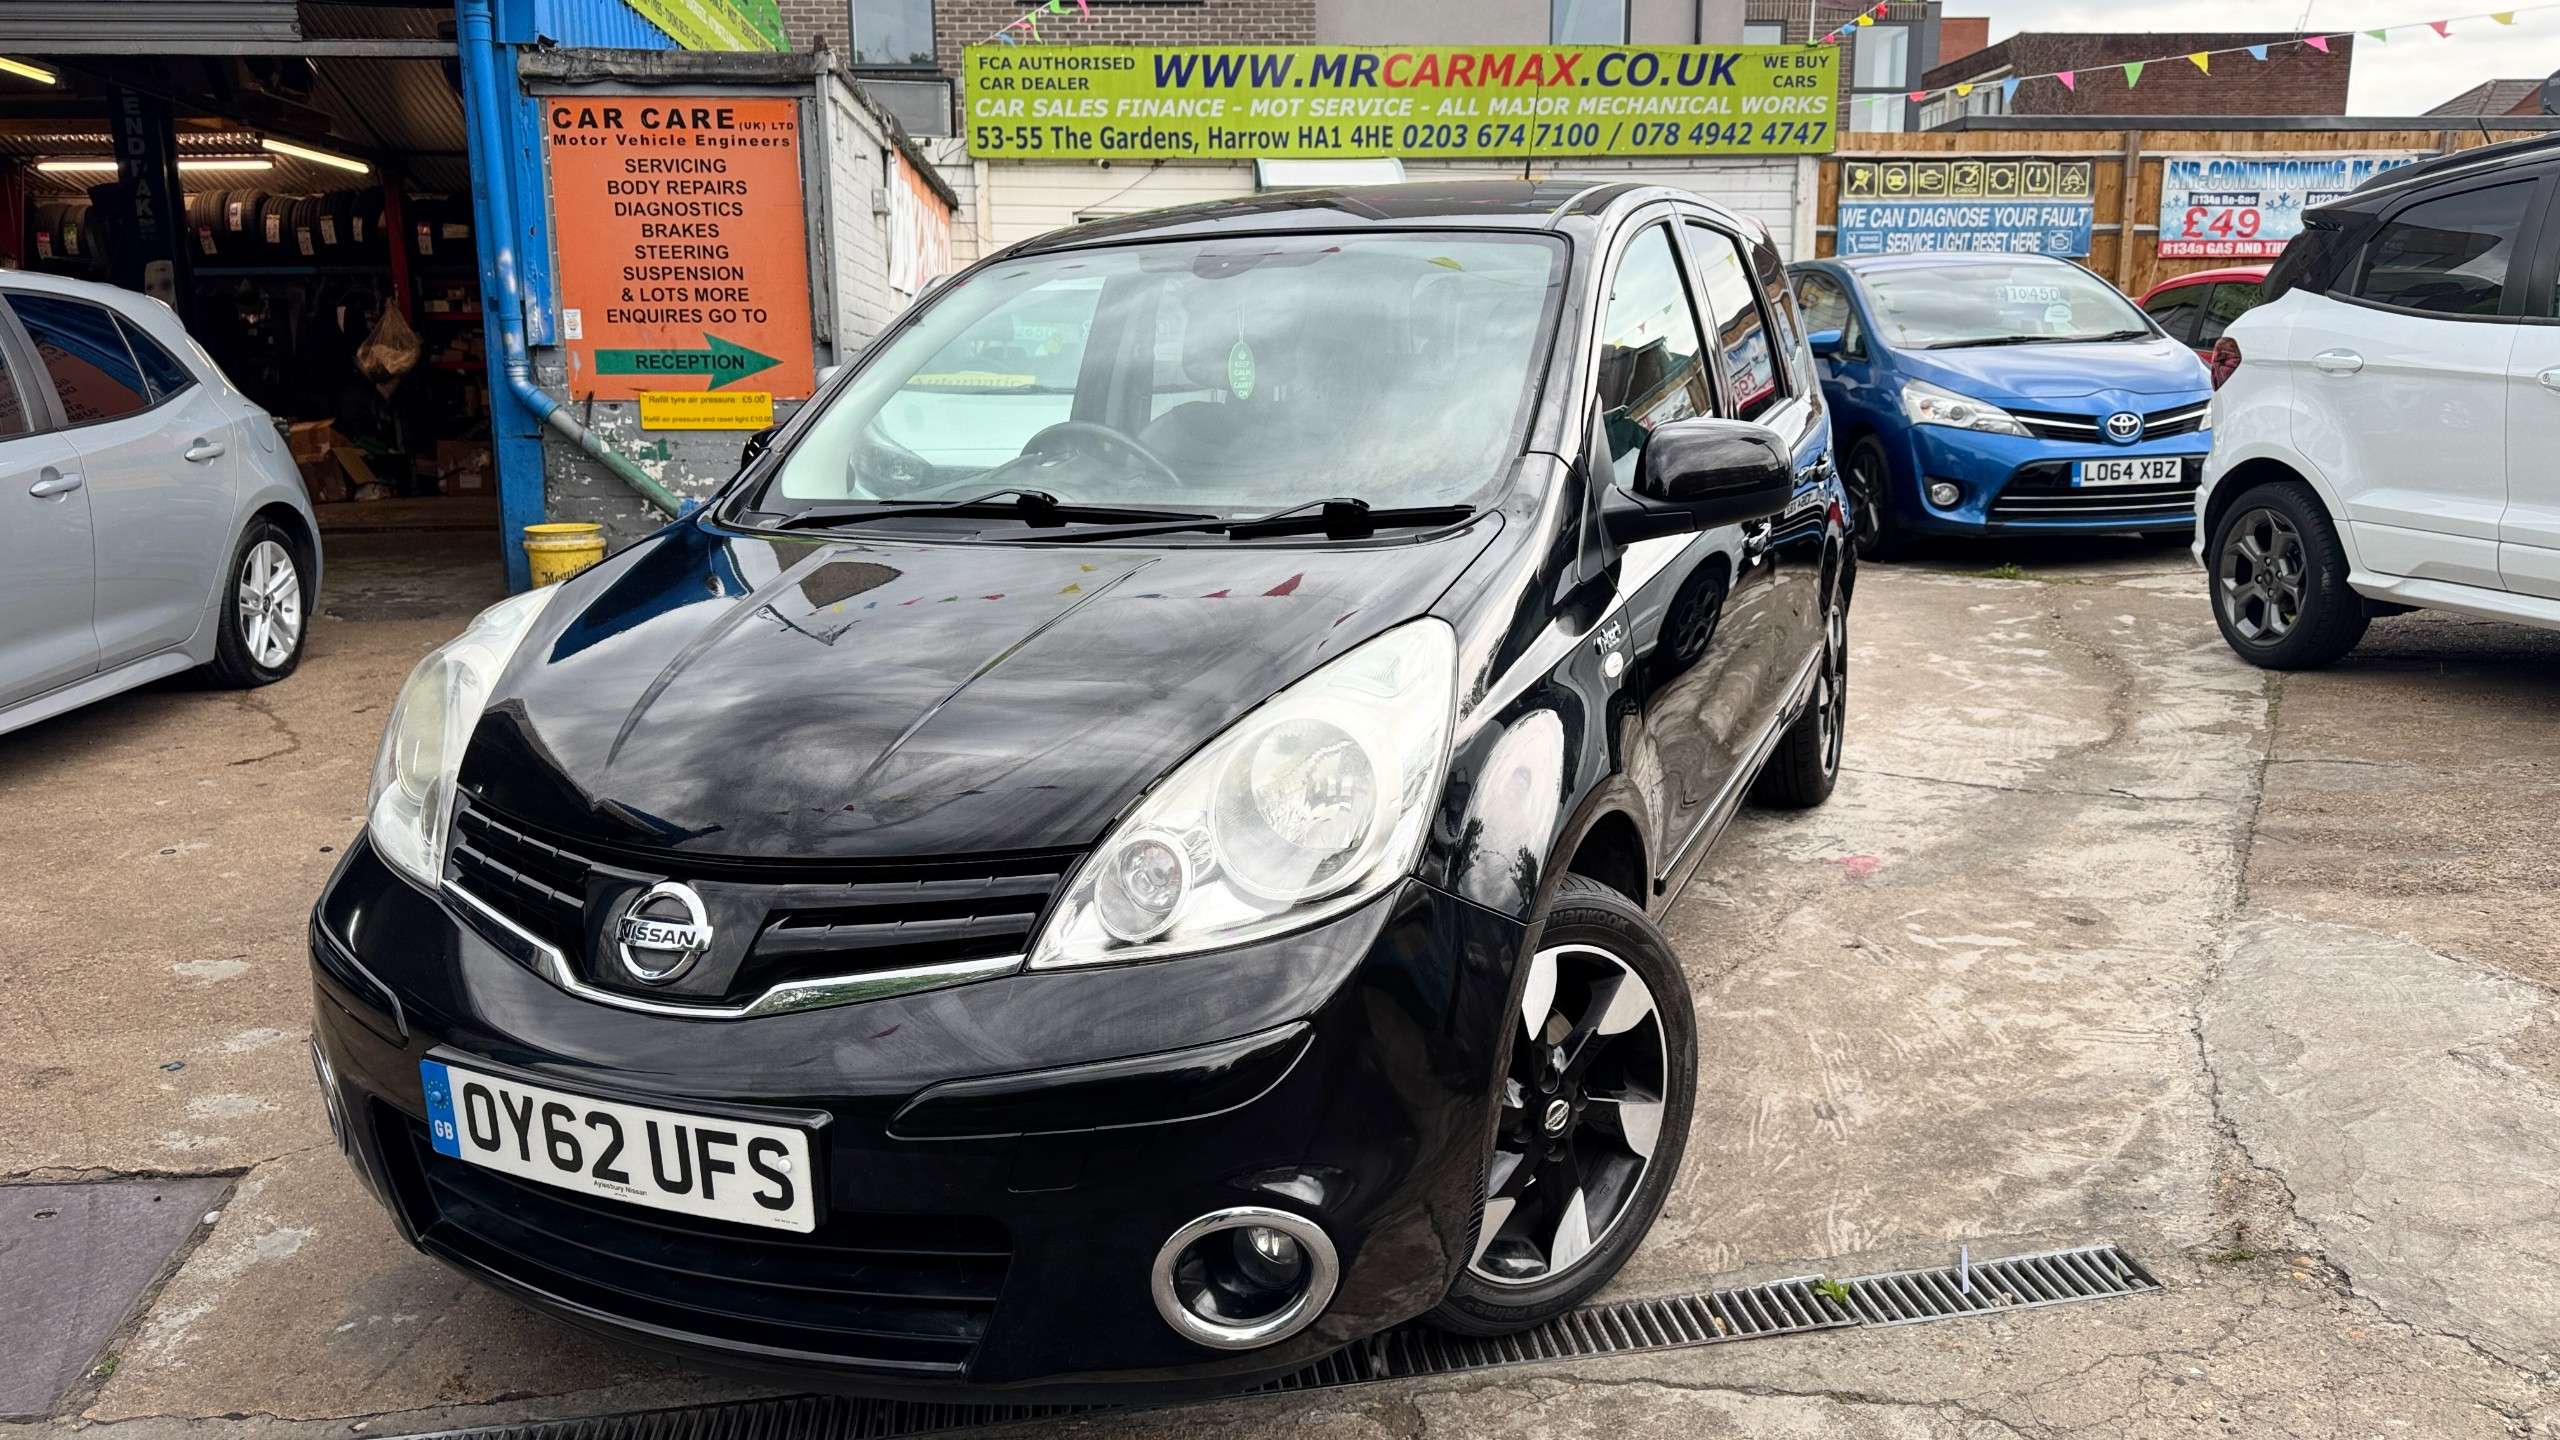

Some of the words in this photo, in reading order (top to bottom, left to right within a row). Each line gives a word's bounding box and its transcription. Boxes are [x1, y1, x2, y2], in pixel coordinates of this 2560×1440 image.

[979, 56, 1014, 71] FCA
[1018, 56, 1135, 71] AUTHORISED
[1763, 55, 1791, 69] WE
[1795, 55, 1829, 69] BUY
[1153, 52, 1744, 89] WWW.MRCARMAX.CO.UK
[979, 77, 1016, 91] CAR
[1021, 77, 1090, 91] DEALER
[1773, 75, 1817, 89] CARS
[975, 98, 1025, 118] CAR
[1031, 98, 1111, 118] SALES
[1115, 98, 1225, 118] FINANCE
[1250, 98, 1302, 117] MOT
[1308, 97, 1413, 117] SERVICE
[1437, 97, 1479, 116] ALL
[1489, 96, 1570, 116] MAJOR
[1577, 96, 1733, 116] MECHANICAL
[1741, 95, 1829, 114] WORKS
[552, 107, 624, 130] CAR
[640, 107, 735, 130] CARE
[739, 121, 766, 131] (UK)
[771, 122, 794, 131] LTD
[553, 134, 608, 146] Motor
[616, 134, 687, 146] Vehicle
[695, 134, 791, 149] Engineers
[977, 126, 1043, 150] 53-55
[1051, 126, 1092, 149] The
[1100, 126, 1199, 154] Gardens,
[1208, 125, 1289, 149] Harrow
[1299, 125, 1341, 149] HA1
[1351, 125, 1394, 149] 4HE
[1403, 123, 1468, 148] 0203
[1477, 123, 1526, 148] 674
[1535, 123, 1600, 147] 7100
[1606, 121, 1623, 151] /
[1631, 122, 1679, 147] 078
[1688, 122, 1752, 146] 4942
[1761, 121, 1828, 145] 4747
[624, 158, 727, 174] SERVICING
[2167, 159, 2347, 191] AIR-CONDITIONING
[607, 180, 660, 195] BODY
[666, 180, 748, 195] REPAIRS
[2221, 195, 2257, 205] Re-Gas
[614, 202, 744, 217] DIAGNOSTICS
[1842, 208, 1868, 228] WE
[1870, 208, 1905, 228] CAN
[1907, 207, 1990, 228] DIAGNOSE
[1994, 207, 2037, 227] YOUR
[2039, 206, 2088, 227] FAULT
[2181, 207, 2260, 238] £49
[641, 223, 720, 238] BRAKES
[1886, 232, 1935, 252] SERVICE
[1937, 233, 1971, 252] LIGHT
[1972, 233, 2009, 252] RESET
[2010, 232, 2041, 252] HERE
[2162, 241, 2204, 255] R134a
[2206, 241, 2233, 254] GAS
[2235, 241, 2262, 254] AND
[634, 245, 729, 260] STEERING
[623, 266, 744, 281] SUSPENSION
[621, 287, 634, 303] &
[640, 288, 689, 302] LOTS
[694, 288, 749, 302] MORE
[606, 309, 703, 324] ENQUIRES
[708, 309, 737, 323] GO
[742, 309, 768, 323] TO
[635, 355, 745, 369] RECEPTION
[648, 395, 668, 404] Refill
[688, 395, 699, 403] air
[701, 396, 735, 405] pressure
[672, 416, 700, 424] pressure
[2084, 460, 2134, 482] LO64
[2139, 459, 2178, 479] XBZ
[620, 918, 696, 946] NISSAN
[434, 1119, 454, 1141] GB
[463, 1082, 630, 1185] OY62
[645, 1120, 794, 1212] UFS
[625, 1187, 648, 1196] Nissan
